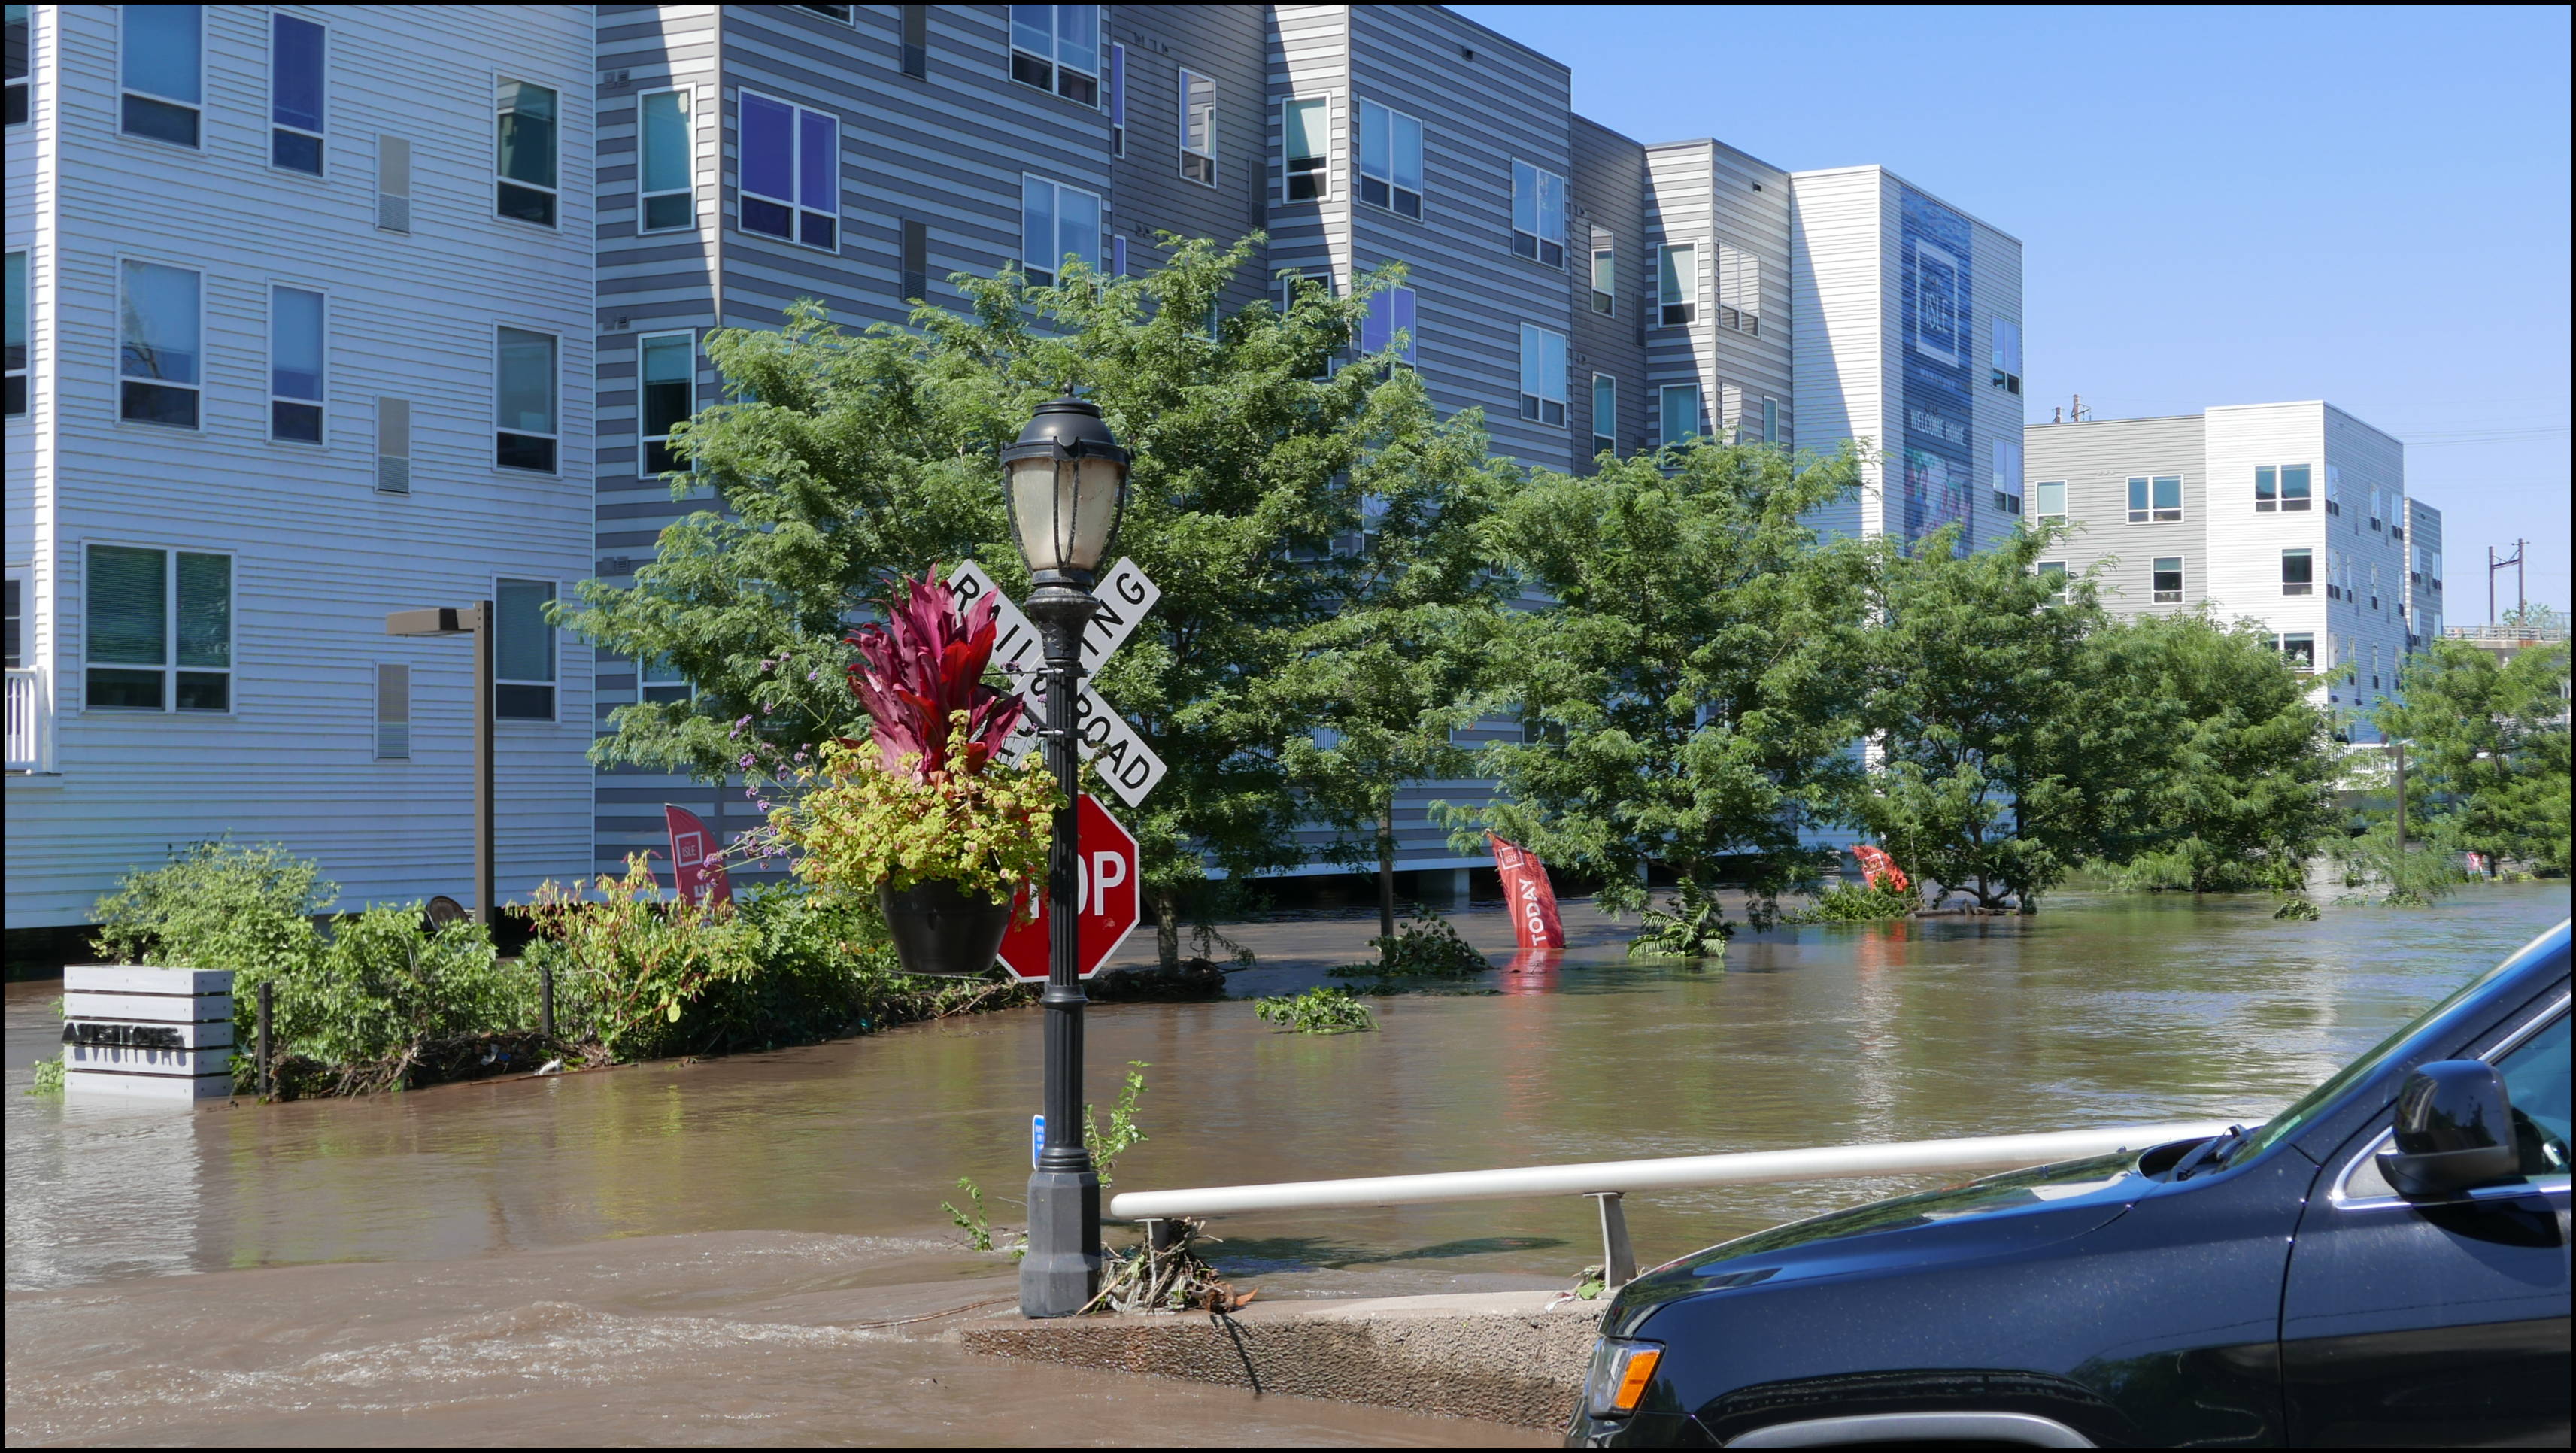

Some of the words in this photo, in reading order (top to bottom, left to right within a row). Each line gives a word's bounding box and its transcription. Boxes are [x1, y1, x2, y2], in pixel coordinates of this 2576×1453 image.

[1925, 292, 1949, 332] ISLE
[1910, 409, 1944, 439] WELCOME
[1945, 421, 1967, 447] HOME
[681, 845, 696, 857] ISLE
[1519, 878, 1548, 947] TODAY
